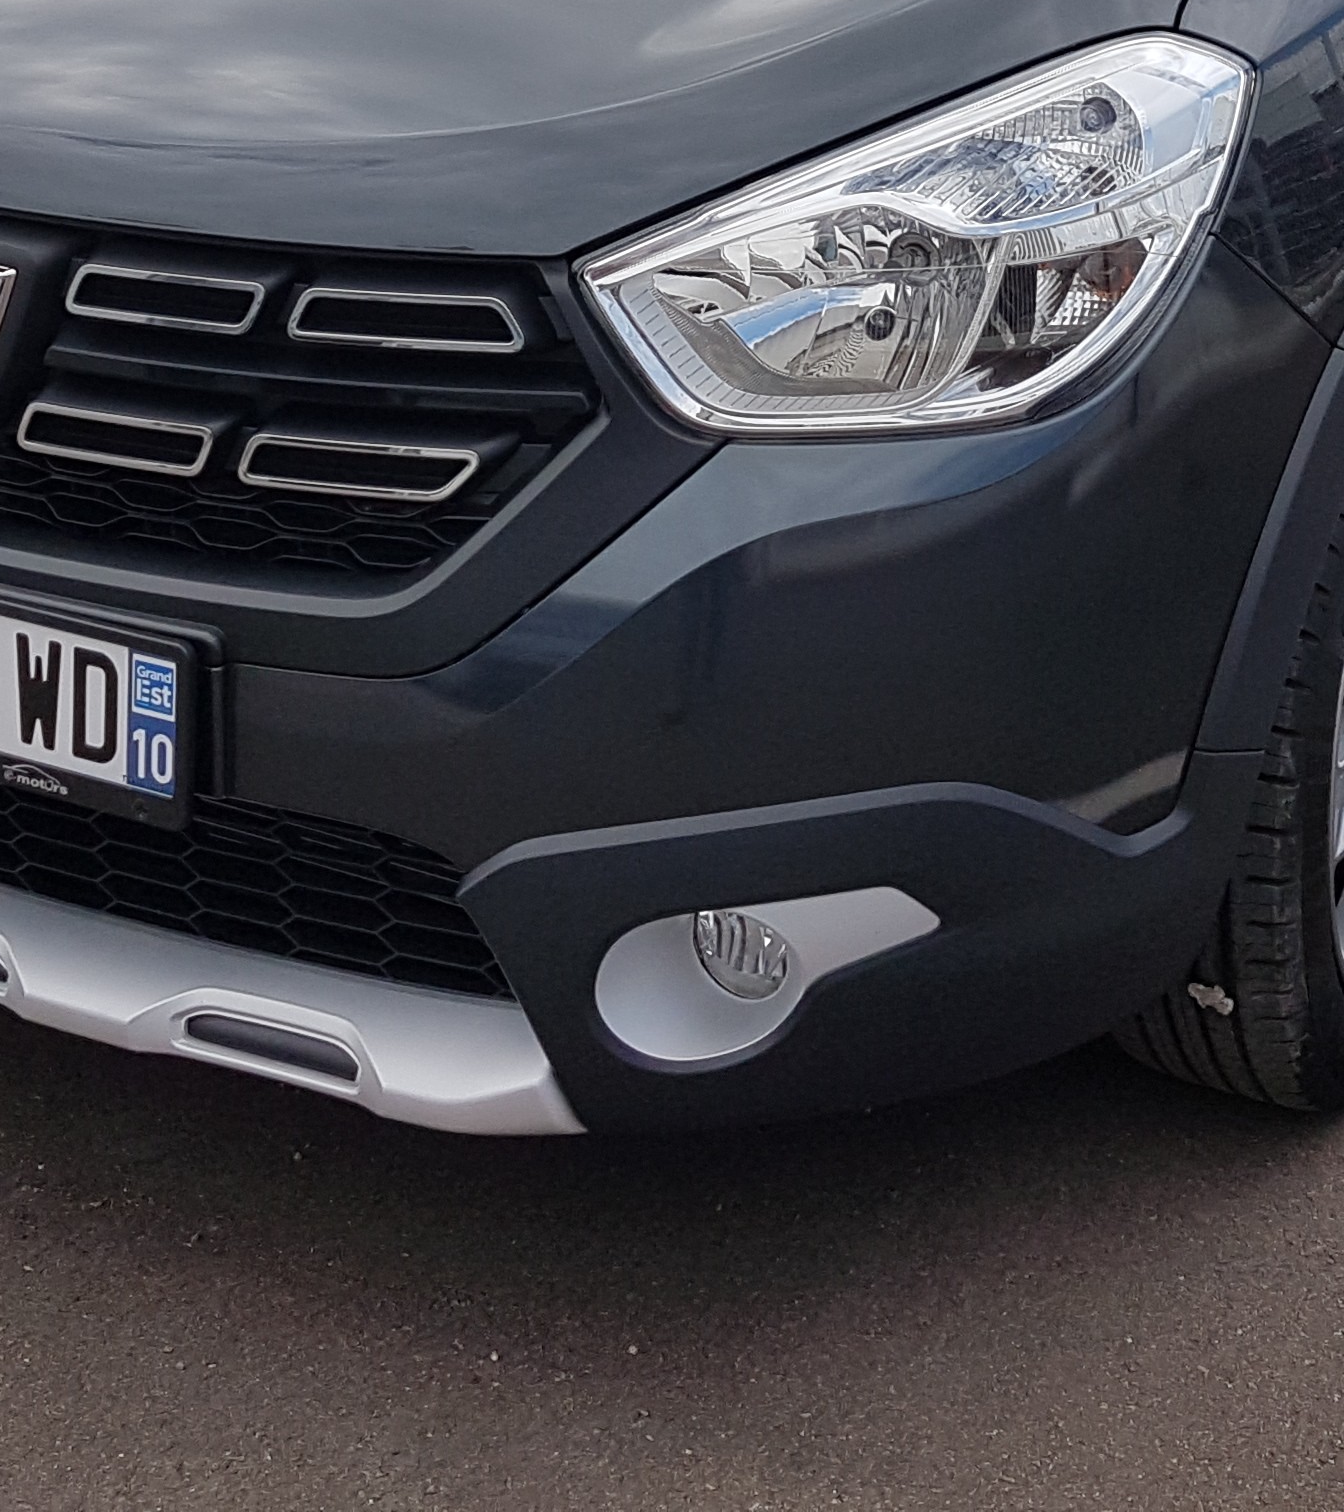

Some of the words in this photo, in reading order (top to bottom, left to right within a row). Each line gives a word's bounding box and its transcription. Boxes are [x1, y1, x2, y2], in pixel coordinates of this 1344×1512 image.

[136, 665, 173, 685] Grand
[136, 678, 172, 708] Est
[132, 728, 173, 784] 10
